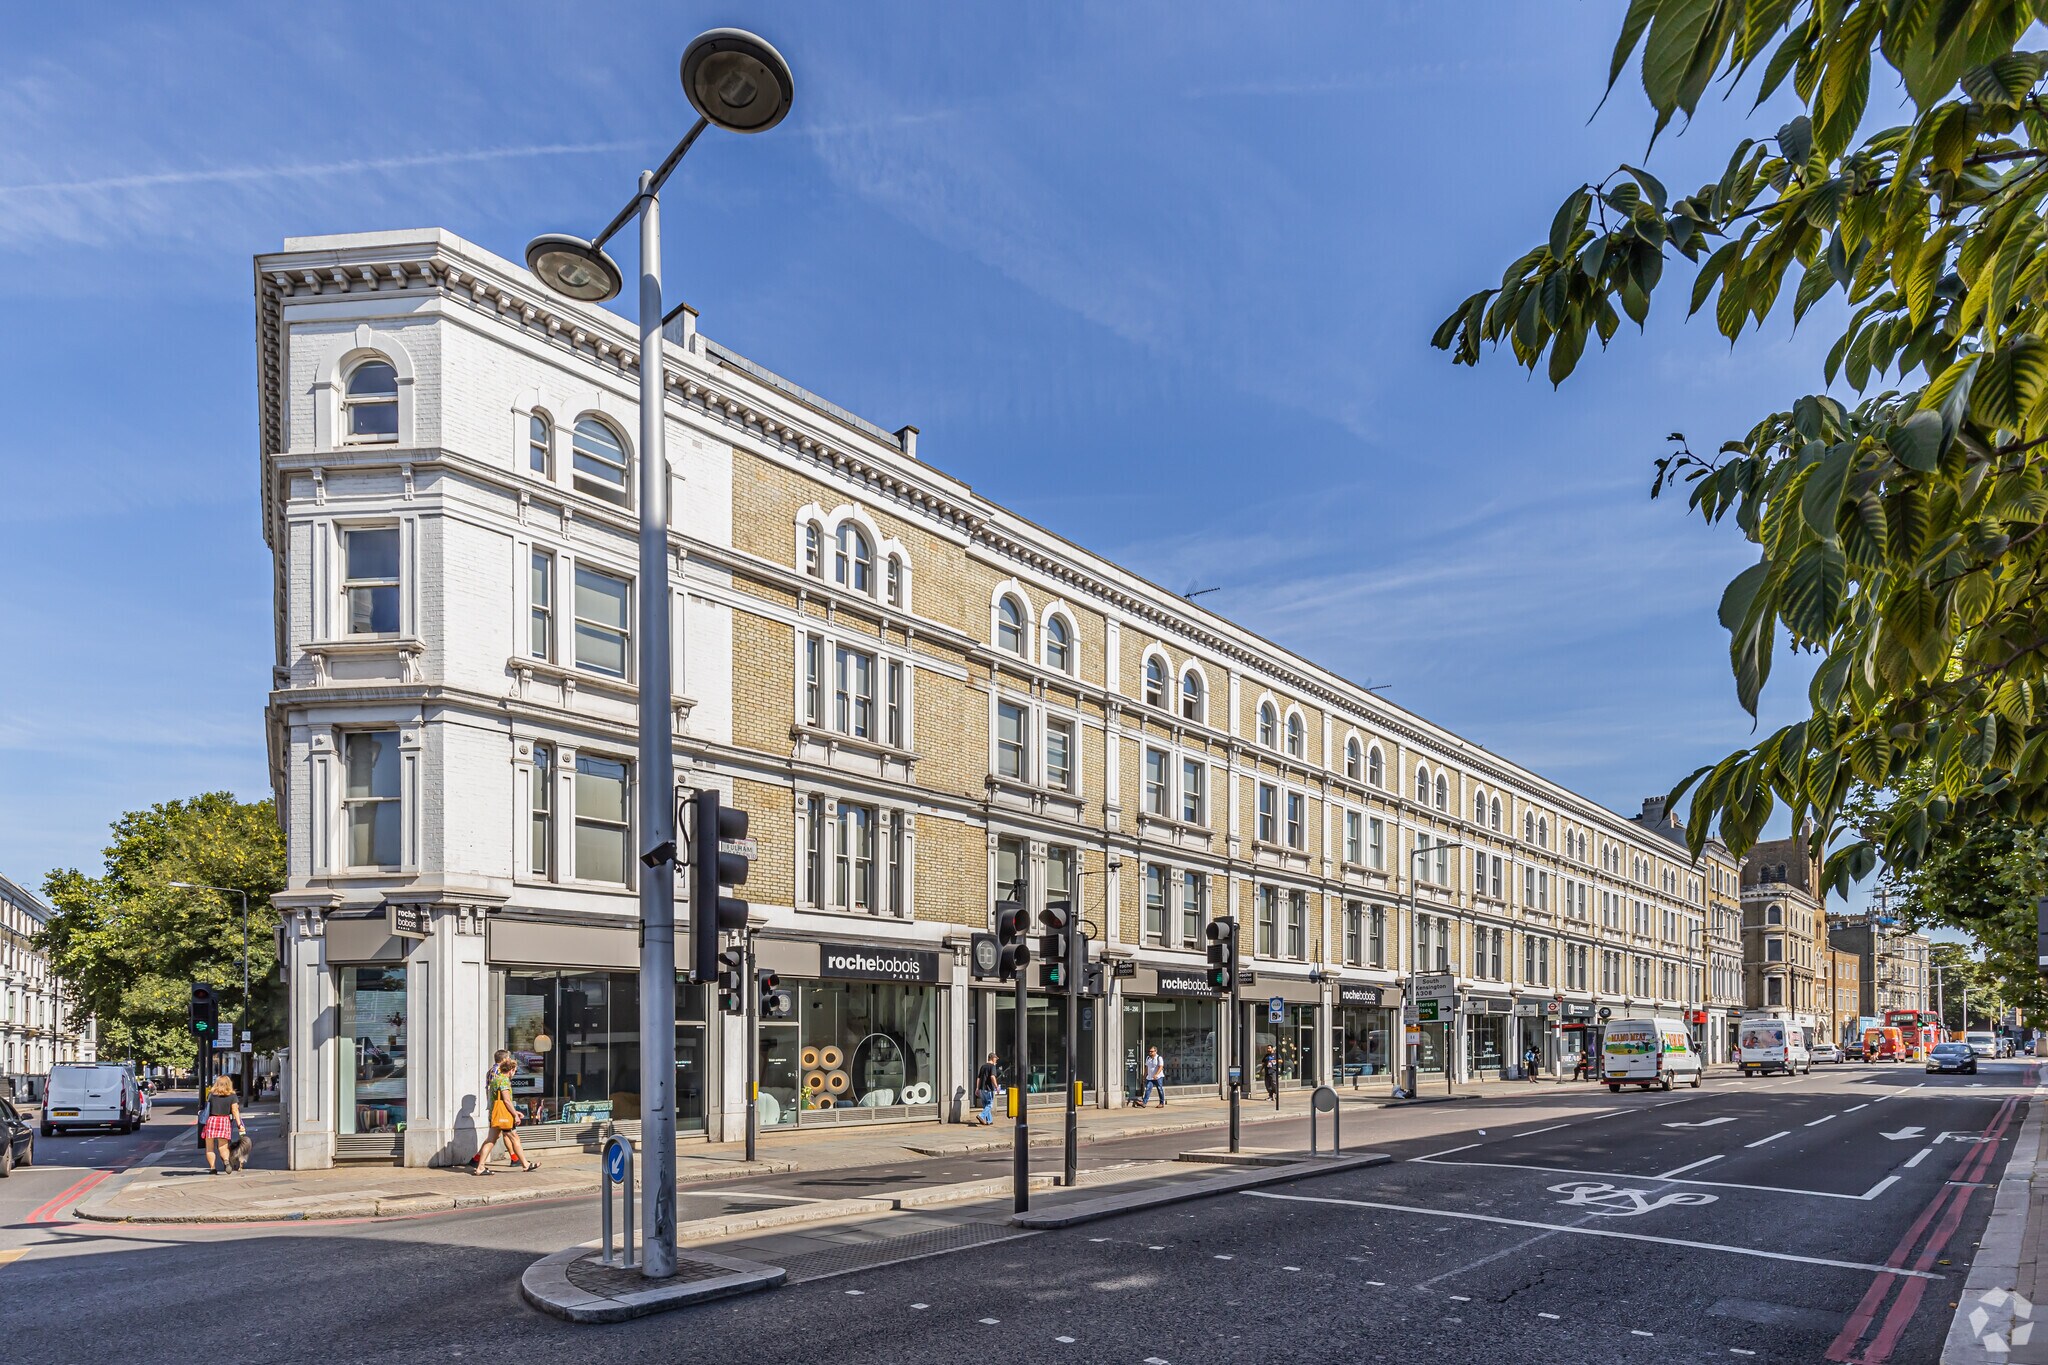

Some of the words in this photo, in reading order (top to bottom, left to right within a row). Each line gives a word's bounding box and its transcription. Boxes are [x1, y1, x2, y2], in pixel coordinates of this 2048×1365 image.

[726, 844, 753, 853] FULHAM
[398, 909, 417, 919] roche
[398, 917, 417, 929] bobois
[828, 954, 920, 974] rochebobois
[1342, 989, 1376, 1001] rochebobois
